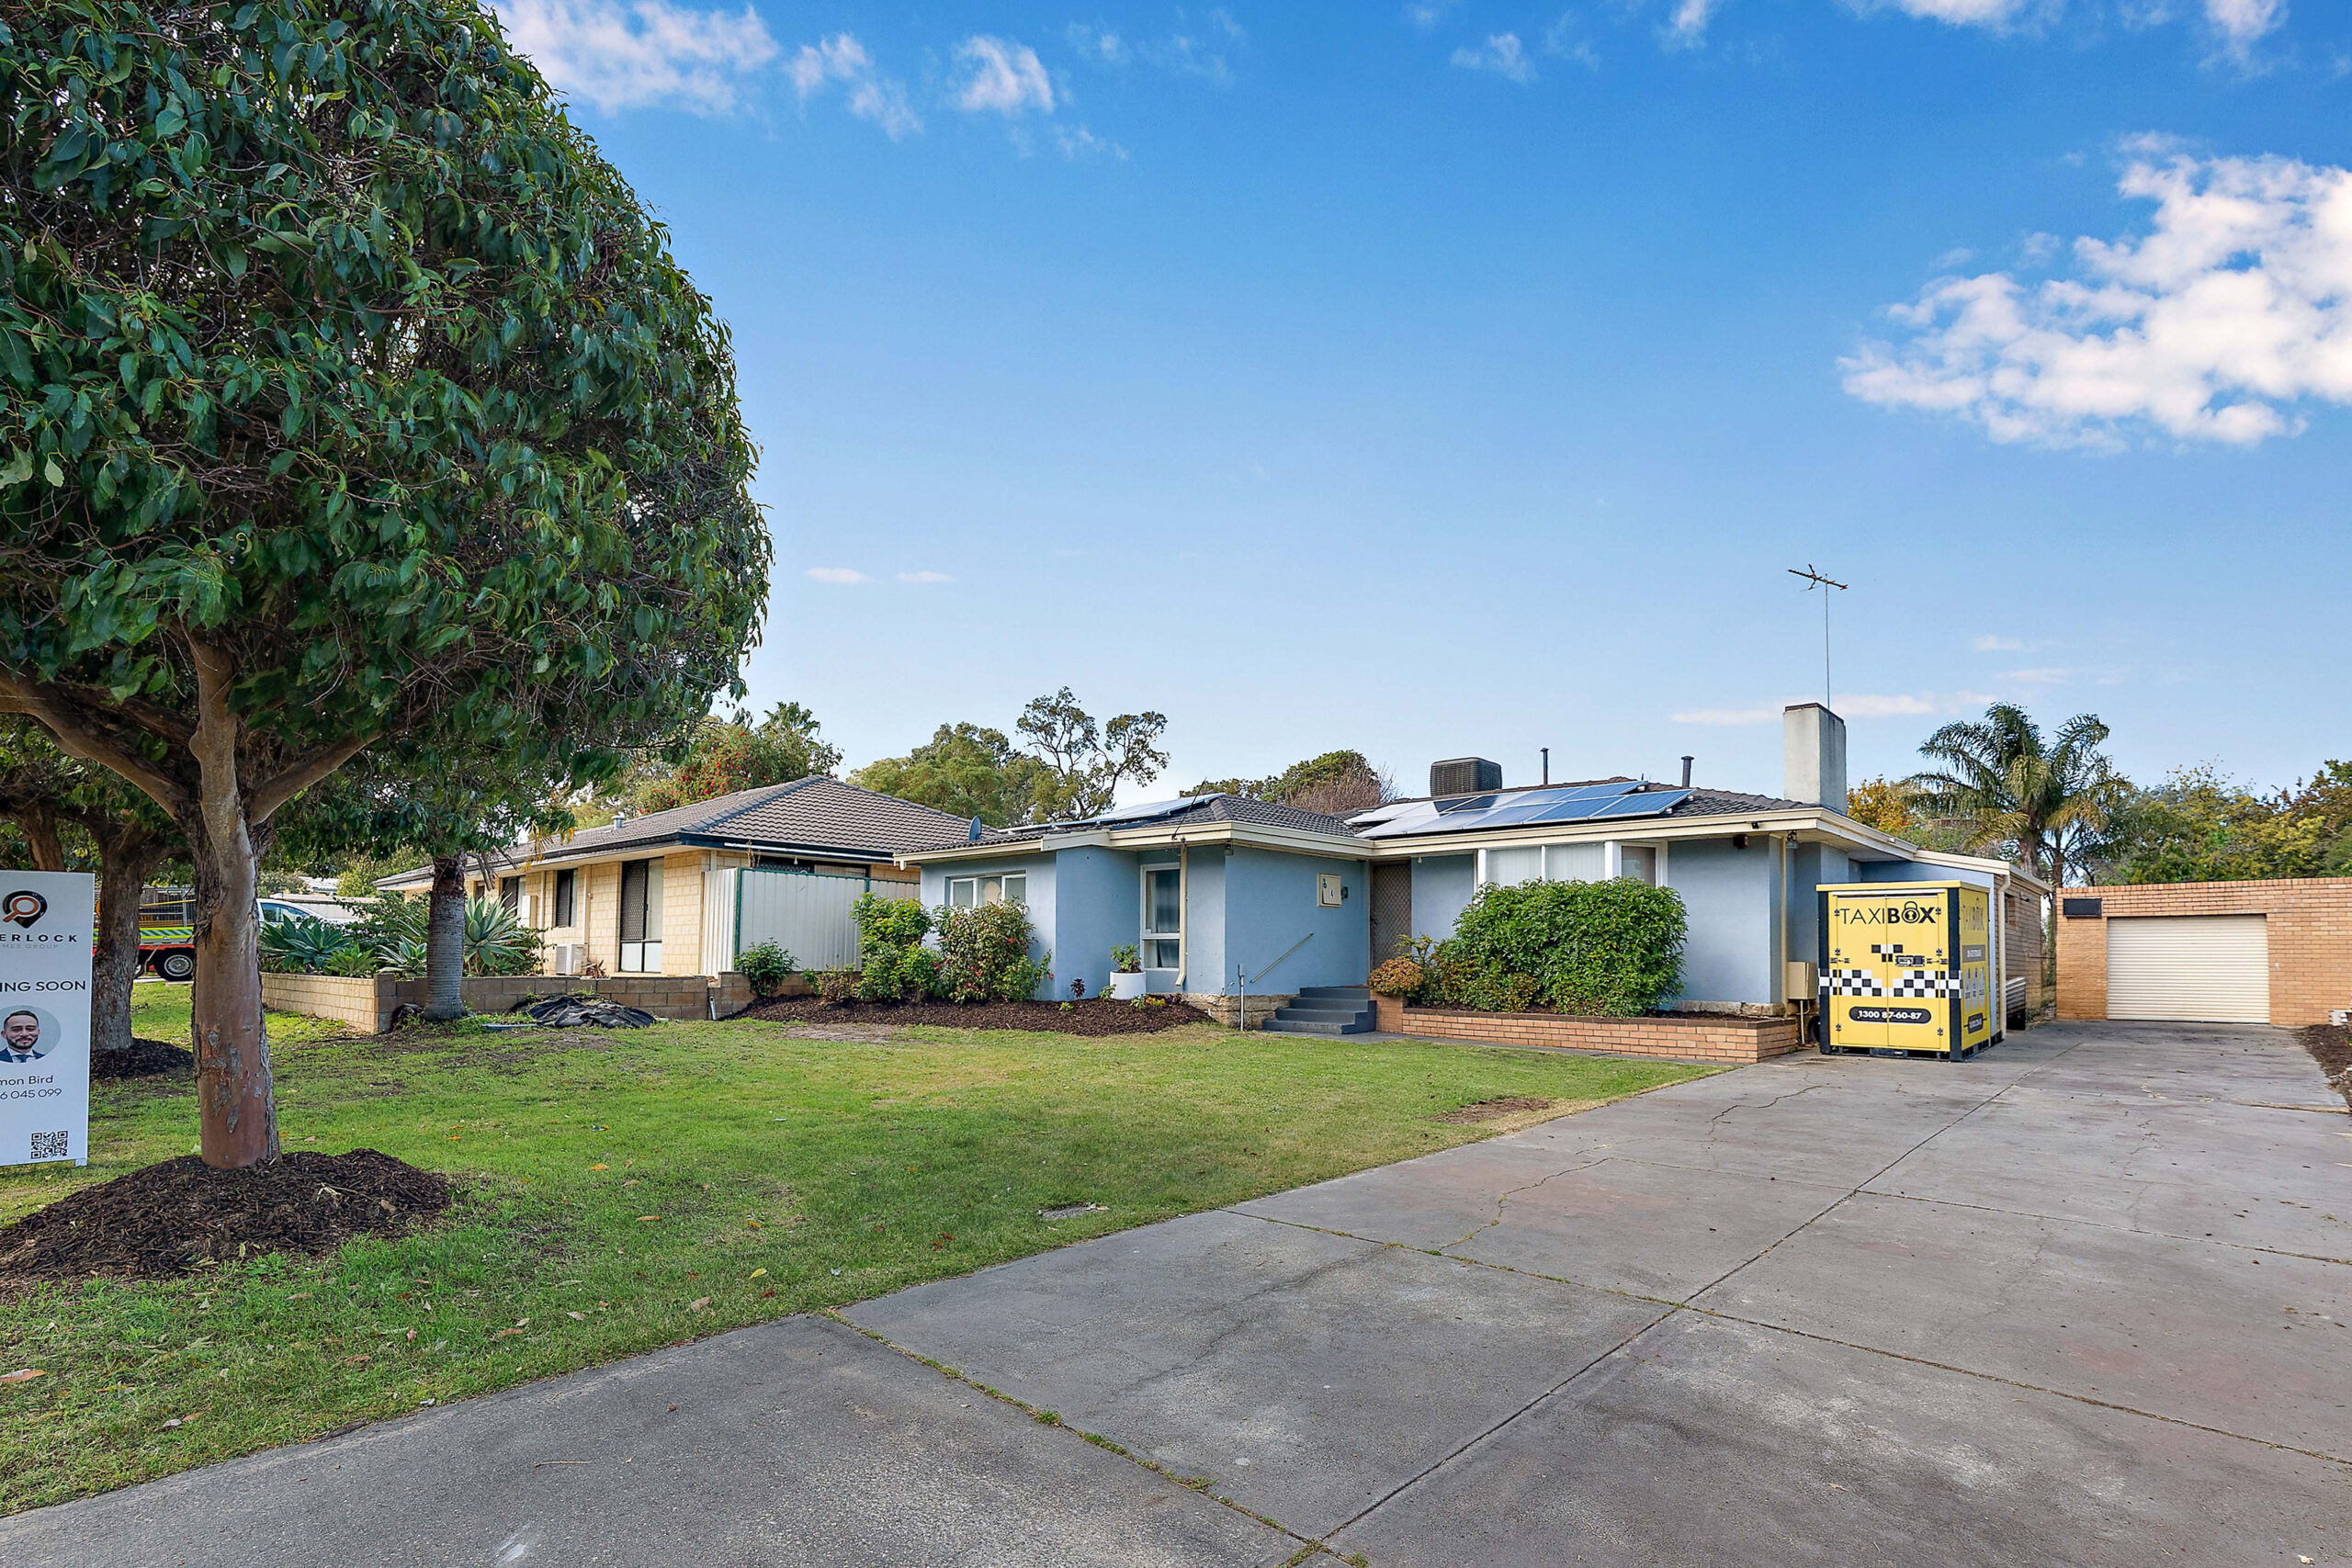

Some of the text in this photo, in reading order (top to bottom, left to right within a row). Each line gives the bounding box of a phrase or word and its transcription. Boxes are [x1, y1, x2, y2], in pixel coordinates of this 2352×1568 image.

[1840, 901, 1936, 924] TAXIBOX
[35, 980, 86, 991] SOON
[1858, 1010, 1923, 1020] 1300 87-60-87
[28, 1075, 53, 1085] Bird
[10, 1089, 36, 1099] 045
[38, 1088, 62, 1098] 099
